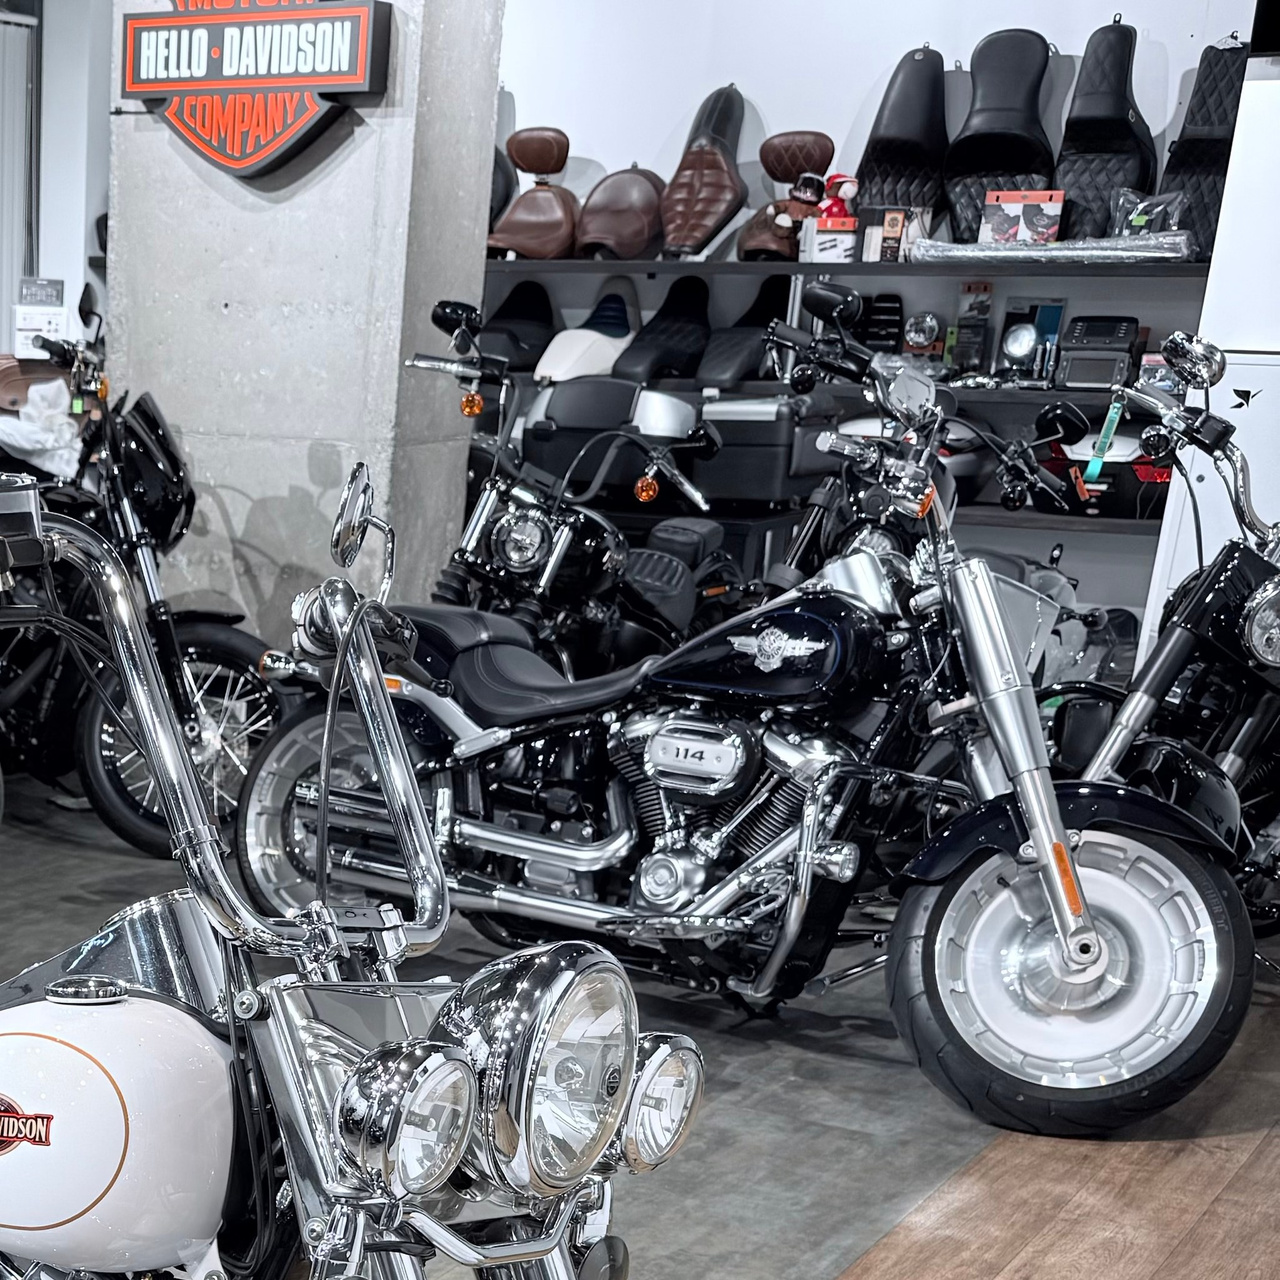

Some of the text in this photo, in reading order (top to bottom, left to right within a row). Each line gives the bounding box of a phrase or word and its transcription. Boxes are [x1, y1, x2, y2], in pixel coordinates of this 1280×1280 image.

[140, 21, 352, 80] HELLO DAVIDSON
[183, 91, 301, 157] COMPANY
[675, 746, 705, 762] 114
